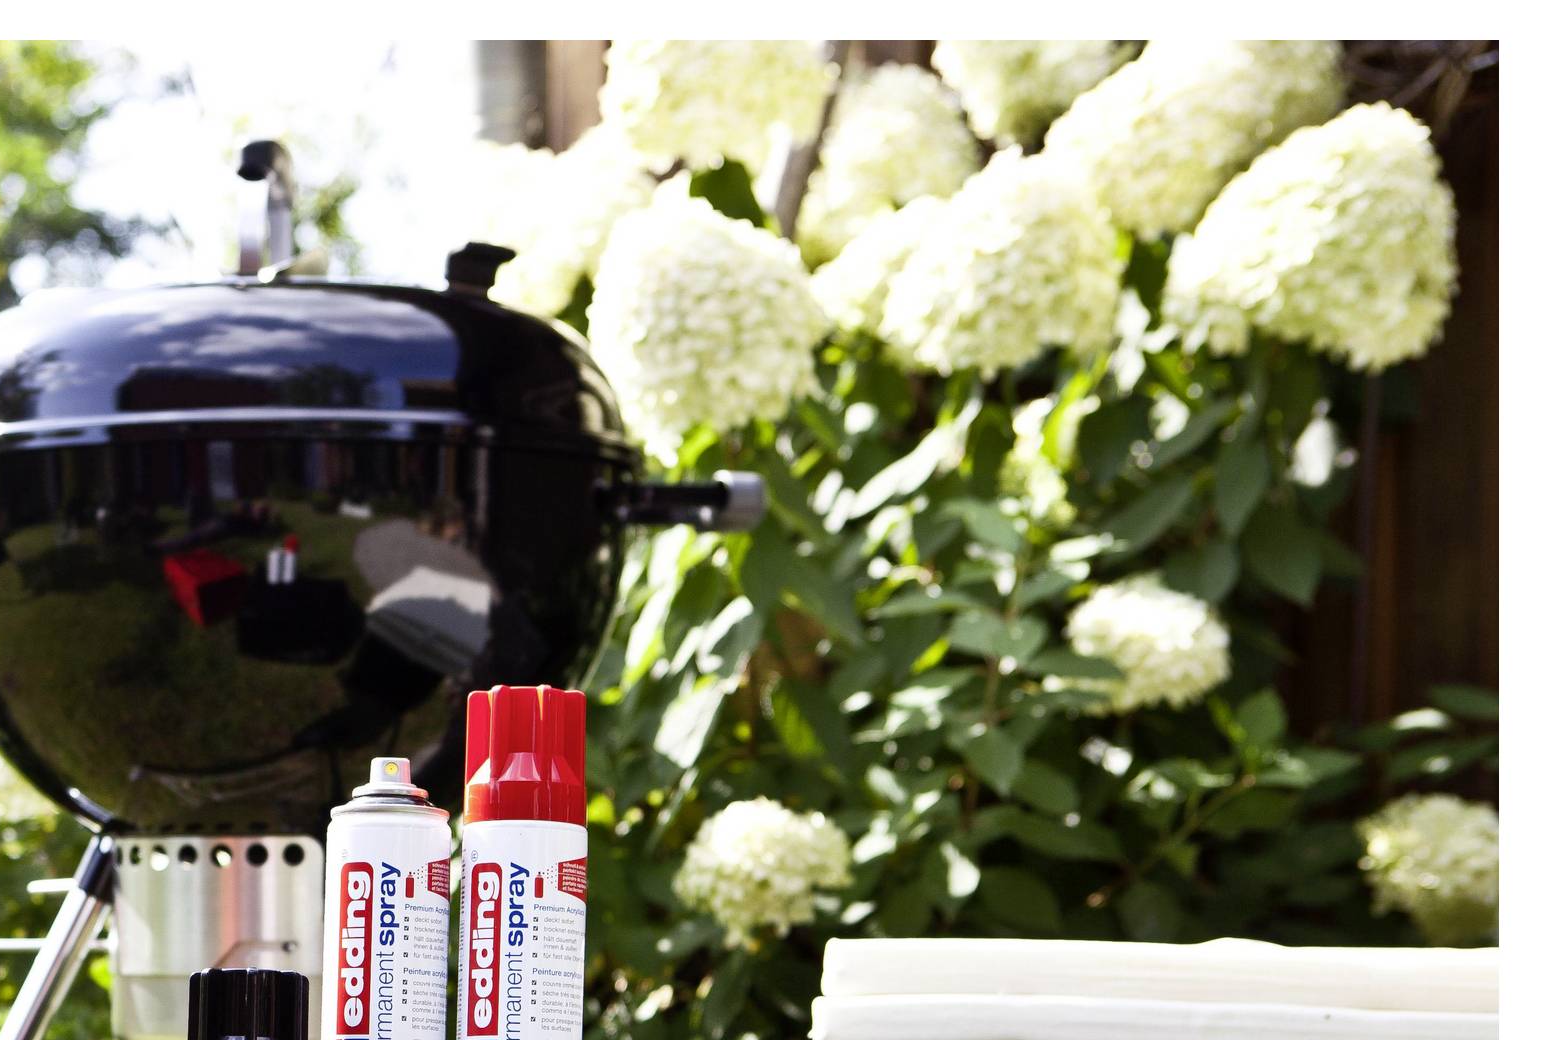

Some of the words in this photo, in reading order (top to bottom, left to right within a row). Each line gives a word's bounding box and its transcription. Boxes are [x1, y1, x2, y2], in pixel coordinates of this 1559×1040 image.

[379, 861, 401, 947] spray
[404, 903, 434, 913] Premium
[507, 861, 530, 948] spray
[533, 903, 565, 913] Premium
[341, 871, 371, 1028] edding
[403, 967, 431, 977] Peinture
[472, 871, 500, 1029] edding
[532, 967, 562, 977] Peinture
